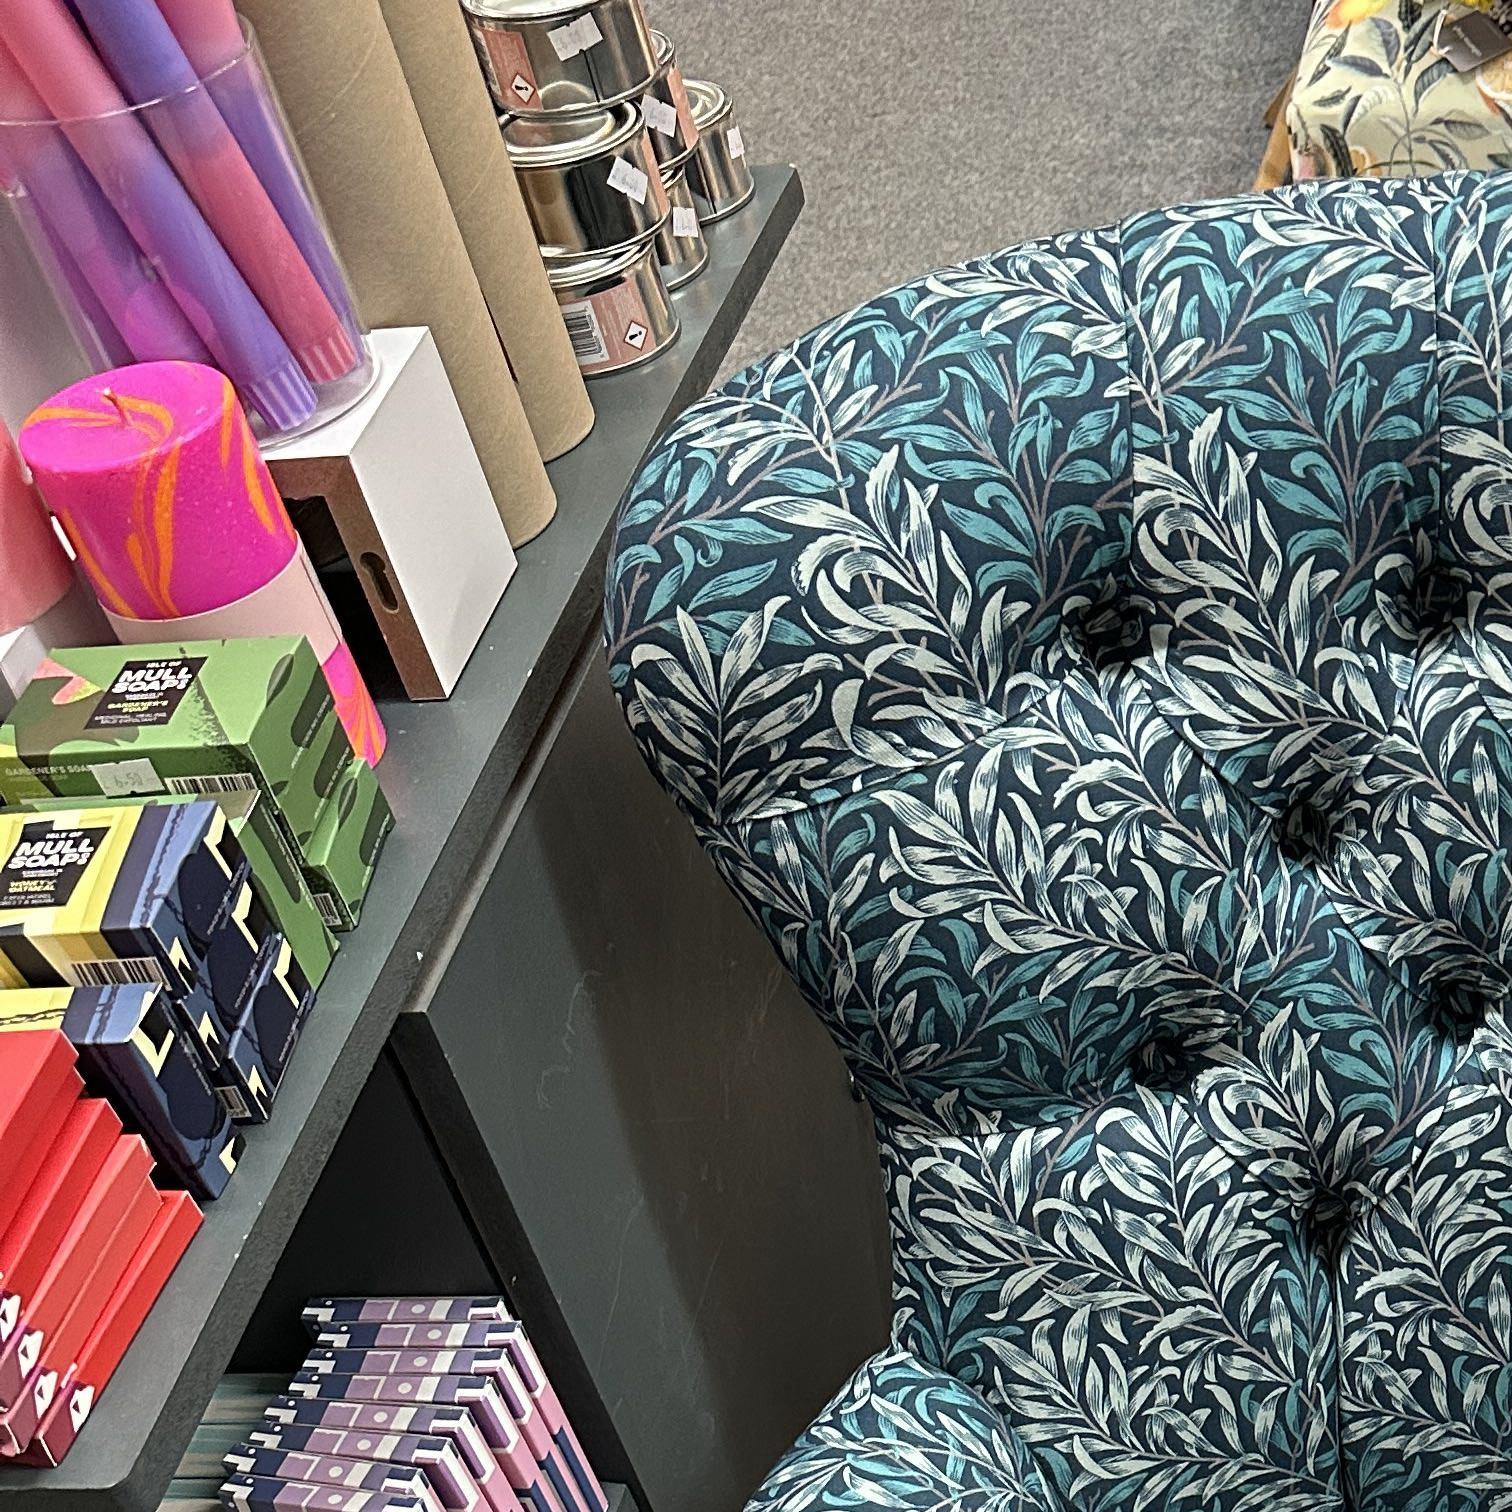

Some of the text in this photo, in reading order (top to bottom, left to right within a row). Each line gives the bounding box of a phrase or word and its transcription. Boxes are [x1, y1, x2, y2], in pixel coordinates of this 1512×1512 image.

[119, 667, 193, 682] MULL
[112, 680, 180, 693] SOAP
[15, 838, 95, 857] MULL
[8, 853, 80, 869] SOAP
